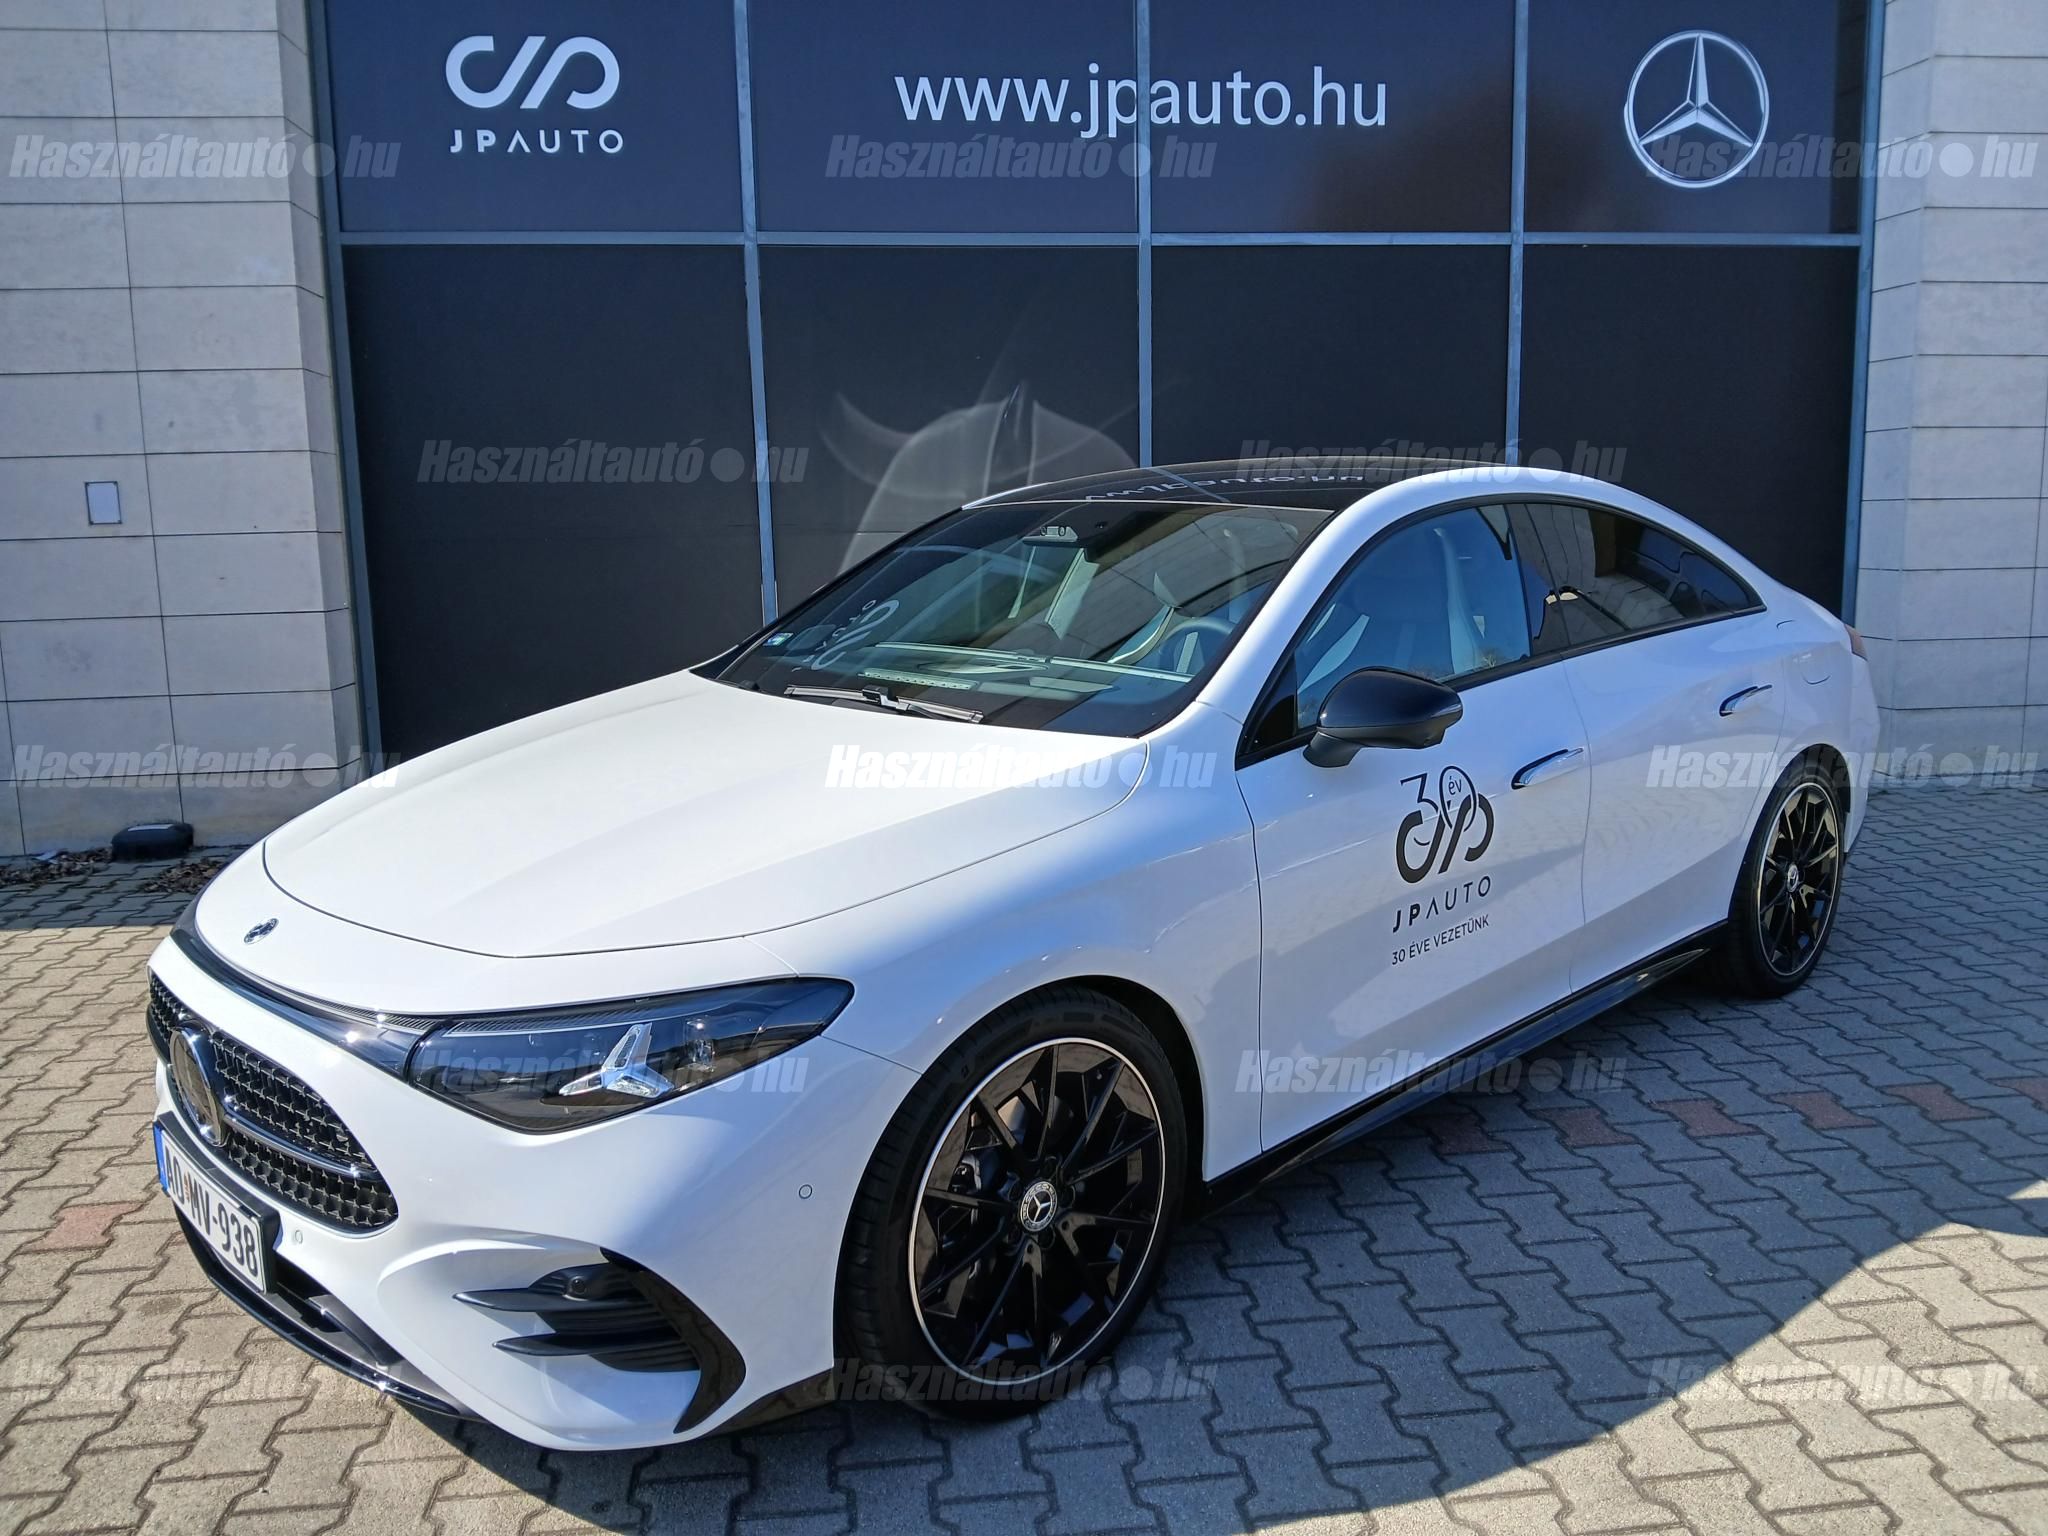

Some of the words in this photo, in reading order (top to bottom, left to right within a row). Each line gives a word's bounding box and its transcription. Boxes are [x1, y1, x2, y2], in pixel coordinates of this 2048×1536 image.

[895, 63, 1387, 138] www.jpauto.hu
[450, 129, 623, 153] JPAUTO
[1392, 875, 1492, 934] JPAUTO
[1391, 949, 1406, 966] 30
[1408, 937, 1431, 960] ÉVE
[1433, 914, 1490, 948] VEZETÜNK
